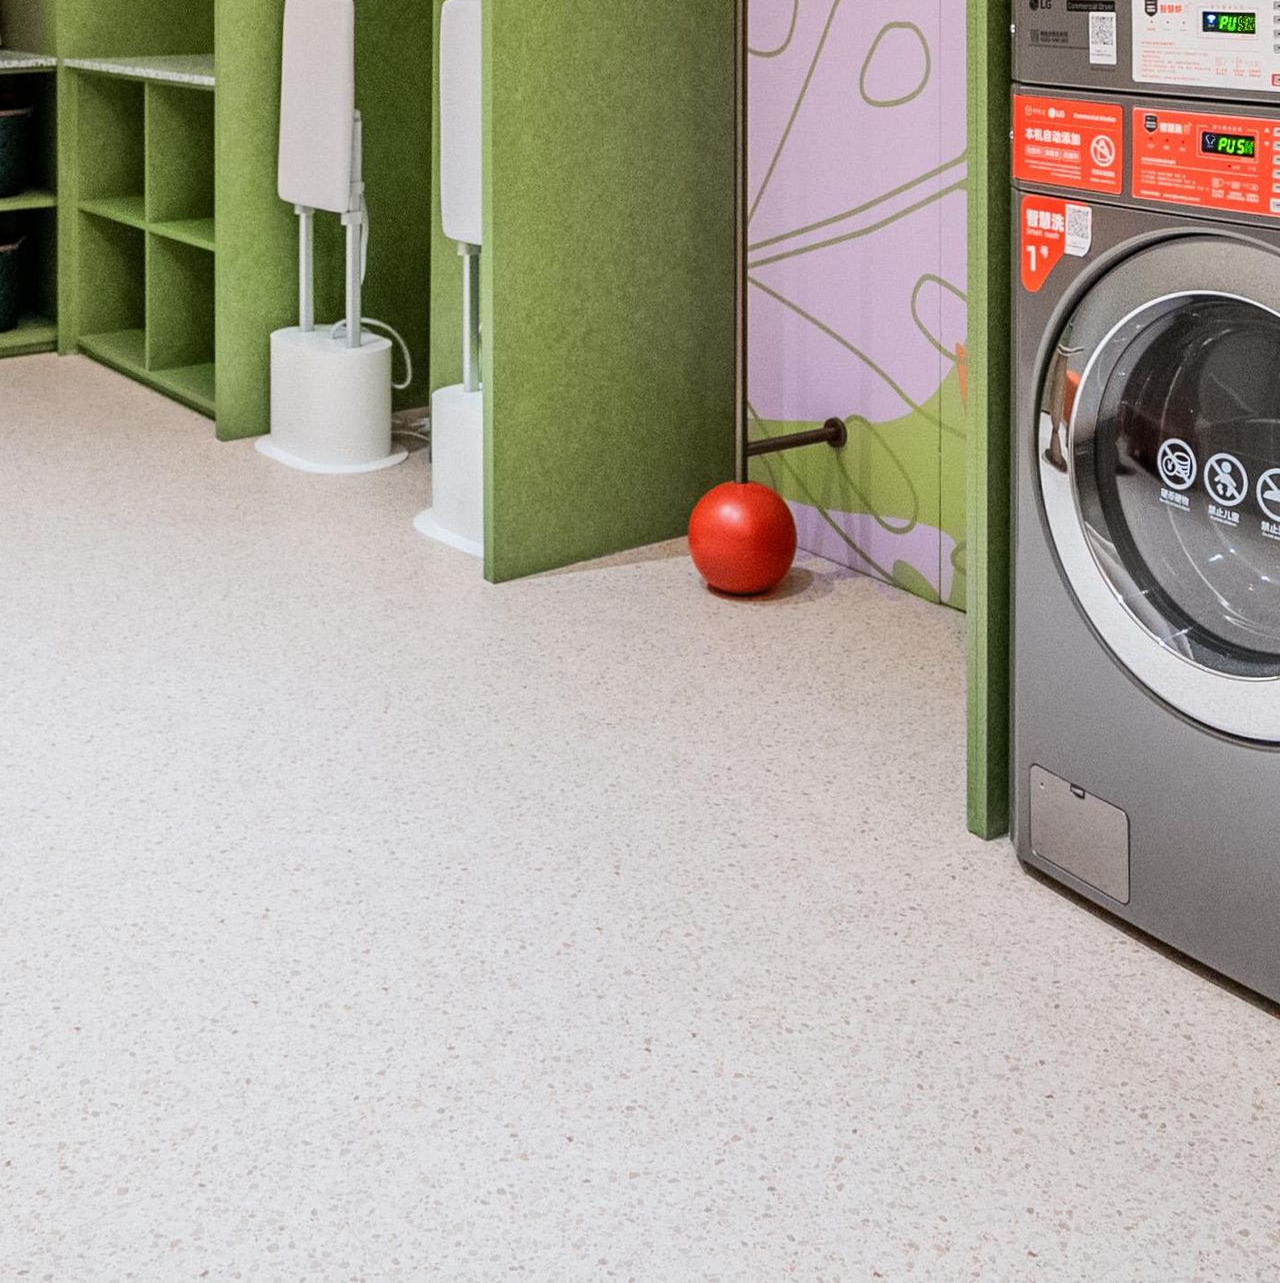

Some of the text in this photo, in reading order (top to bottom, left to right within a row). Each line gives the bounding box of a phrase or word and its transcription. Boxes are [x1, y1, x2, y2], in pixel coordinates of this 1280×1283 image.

[1040, 0, 1052, 10] LG
[1026, 208, 1064, 233] 智慧洗
